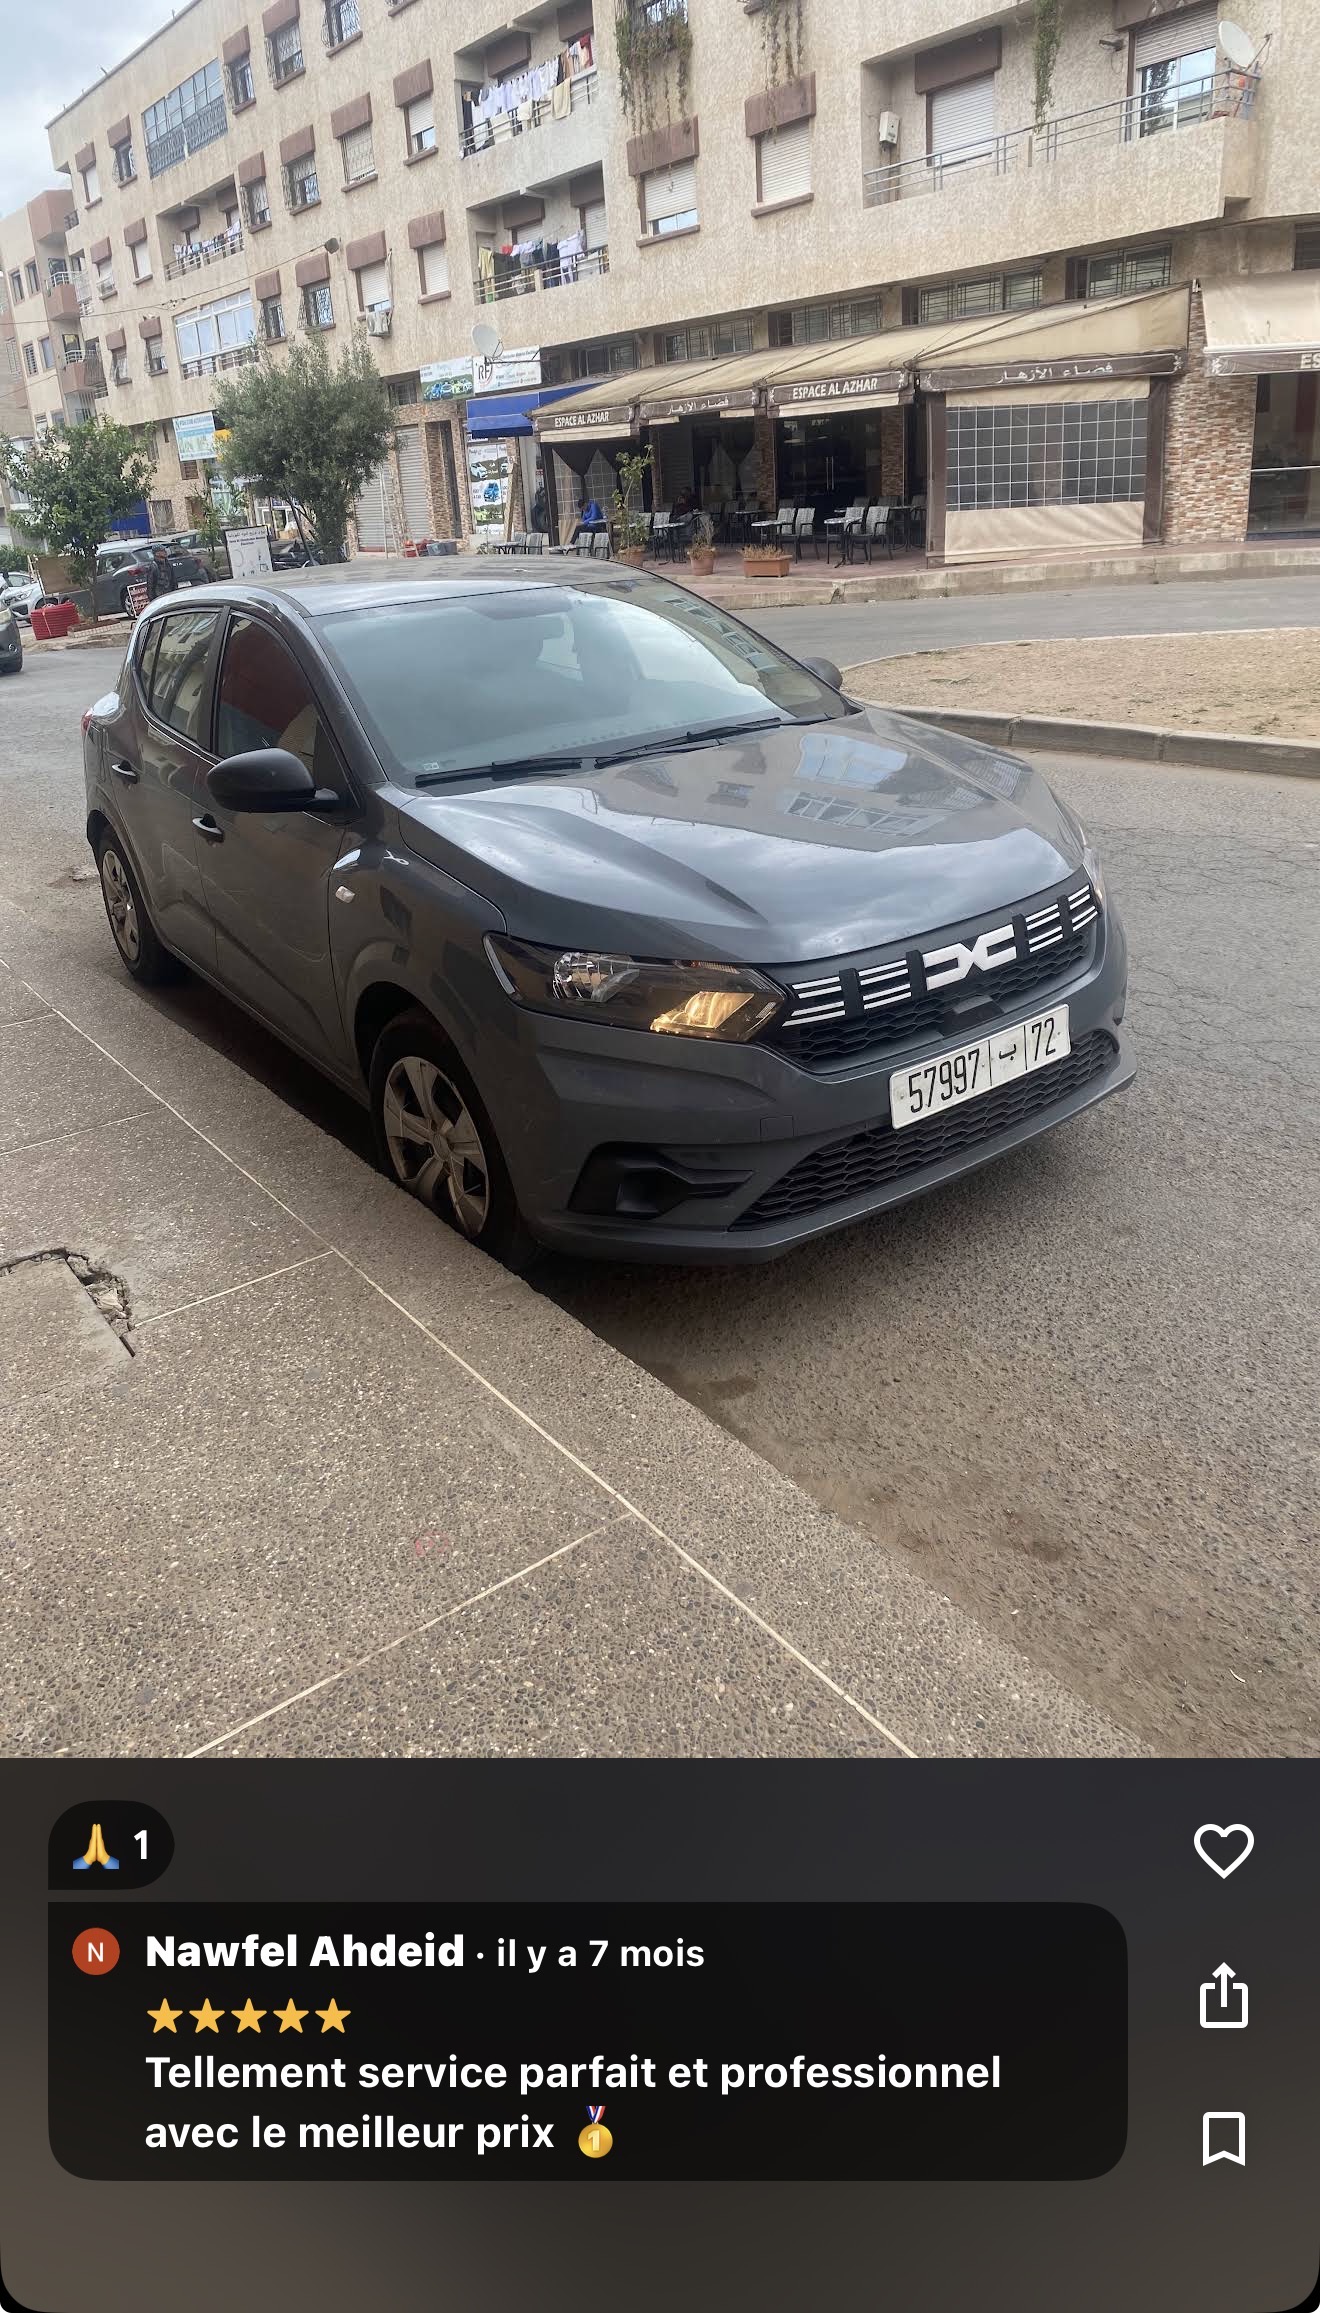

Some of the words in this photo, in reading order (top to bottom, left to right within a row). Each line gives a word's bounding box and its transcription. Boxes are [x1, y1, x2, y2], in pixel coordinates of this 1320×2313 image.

[996, 366, 1053, 384] الأزهار
[1063, 362, 1114, 377] فضاء
[792, 383, 827, 400] ESPACE
[828, 382, 841, 396] AL
[841, 377, 878, 394] AZHAR
[666, 401, 697, 415] الأزهار
[701, 395, 729, 410] فضاء
[554, 415, 577, 428] ESPACE
[577, 414, 587, 425] AL
[586, 411, 609, 425] AZHAR
[907, 1048, 980, 1114] 57997
[998, 1043, 1017, 1062] ب
[1031, 1017, 1057, 1062] 72
